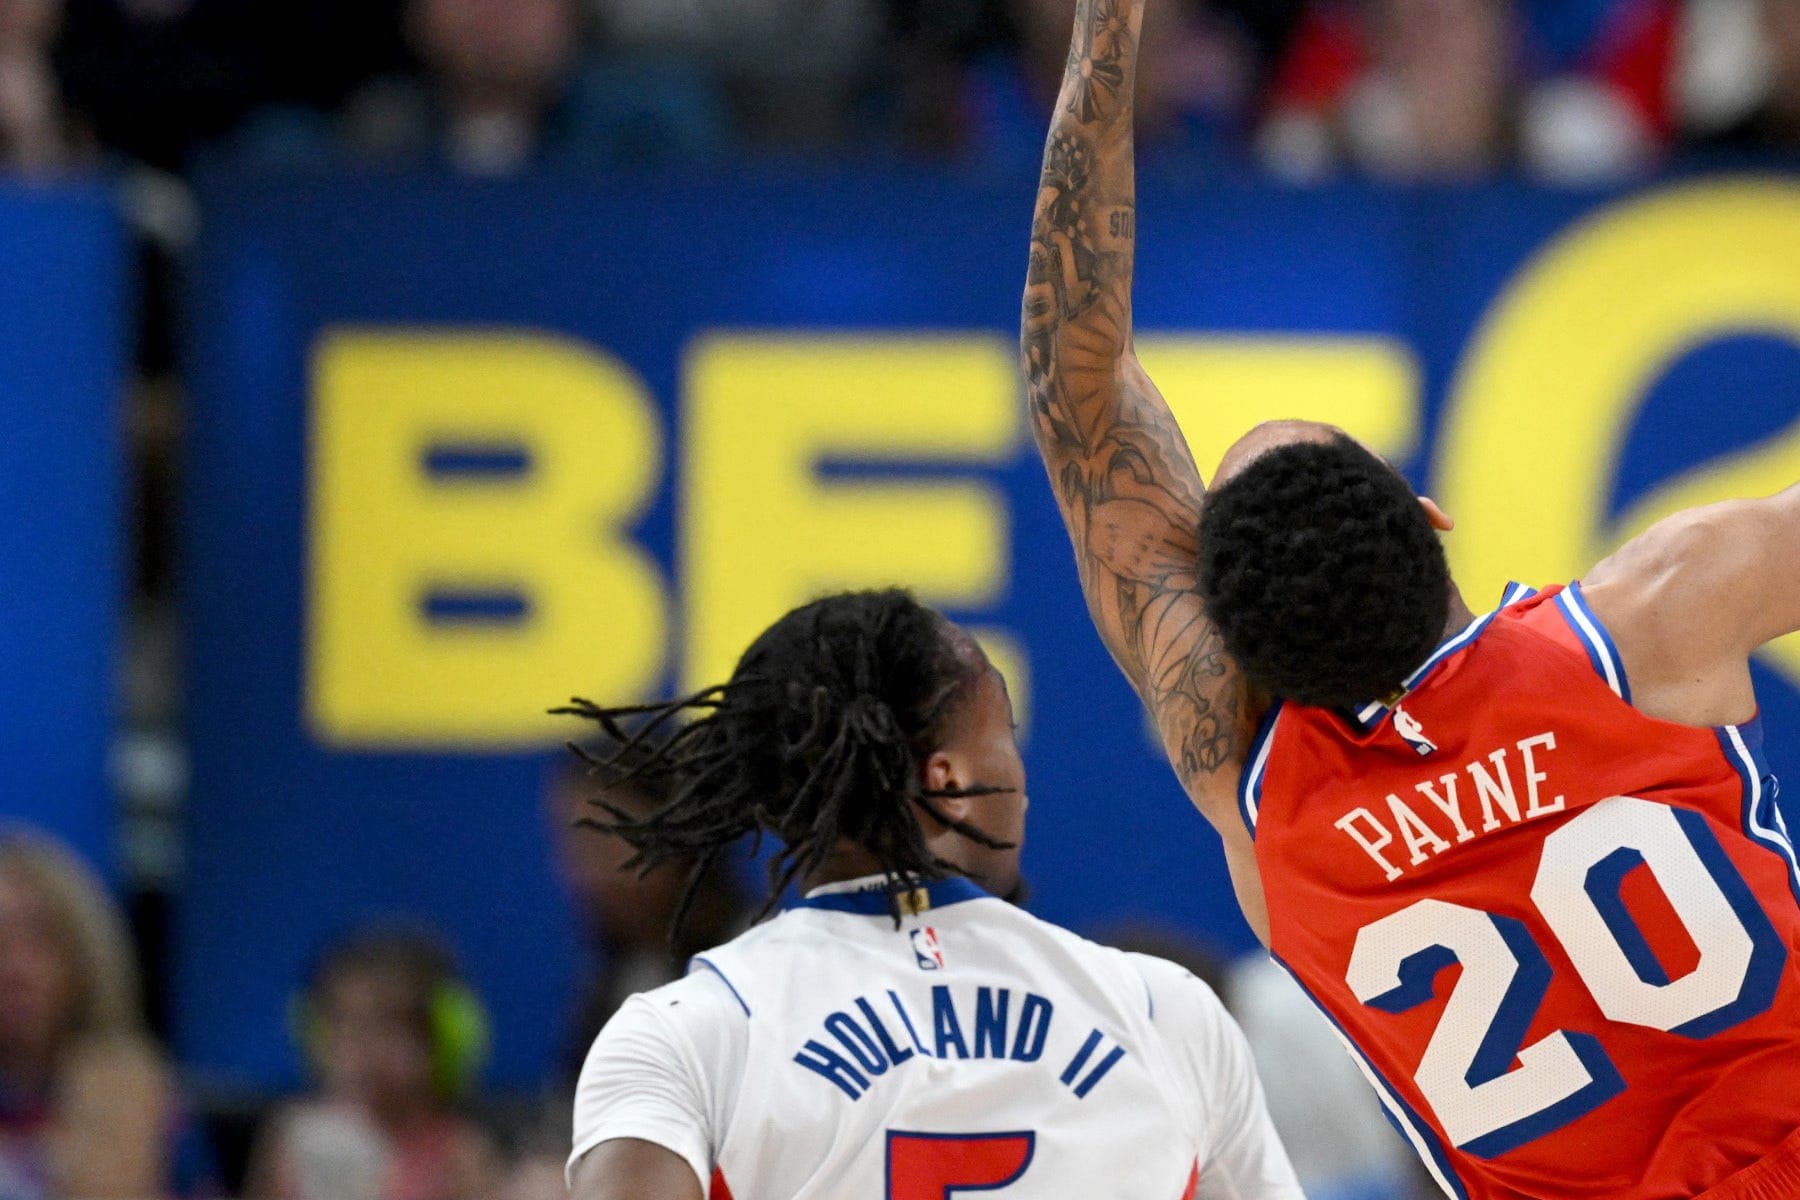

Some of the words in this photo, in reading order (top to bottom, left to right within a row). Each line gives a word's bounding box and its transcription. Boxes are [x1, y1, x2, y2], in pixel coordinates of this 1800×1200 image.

[1334, 731, 1565, 882] PAYNE
[793, 985, 1054, 1102] HOLLAND
[1059, 1028, 1126, 1099] II
[1344, 795, 1788, 1161] 20
